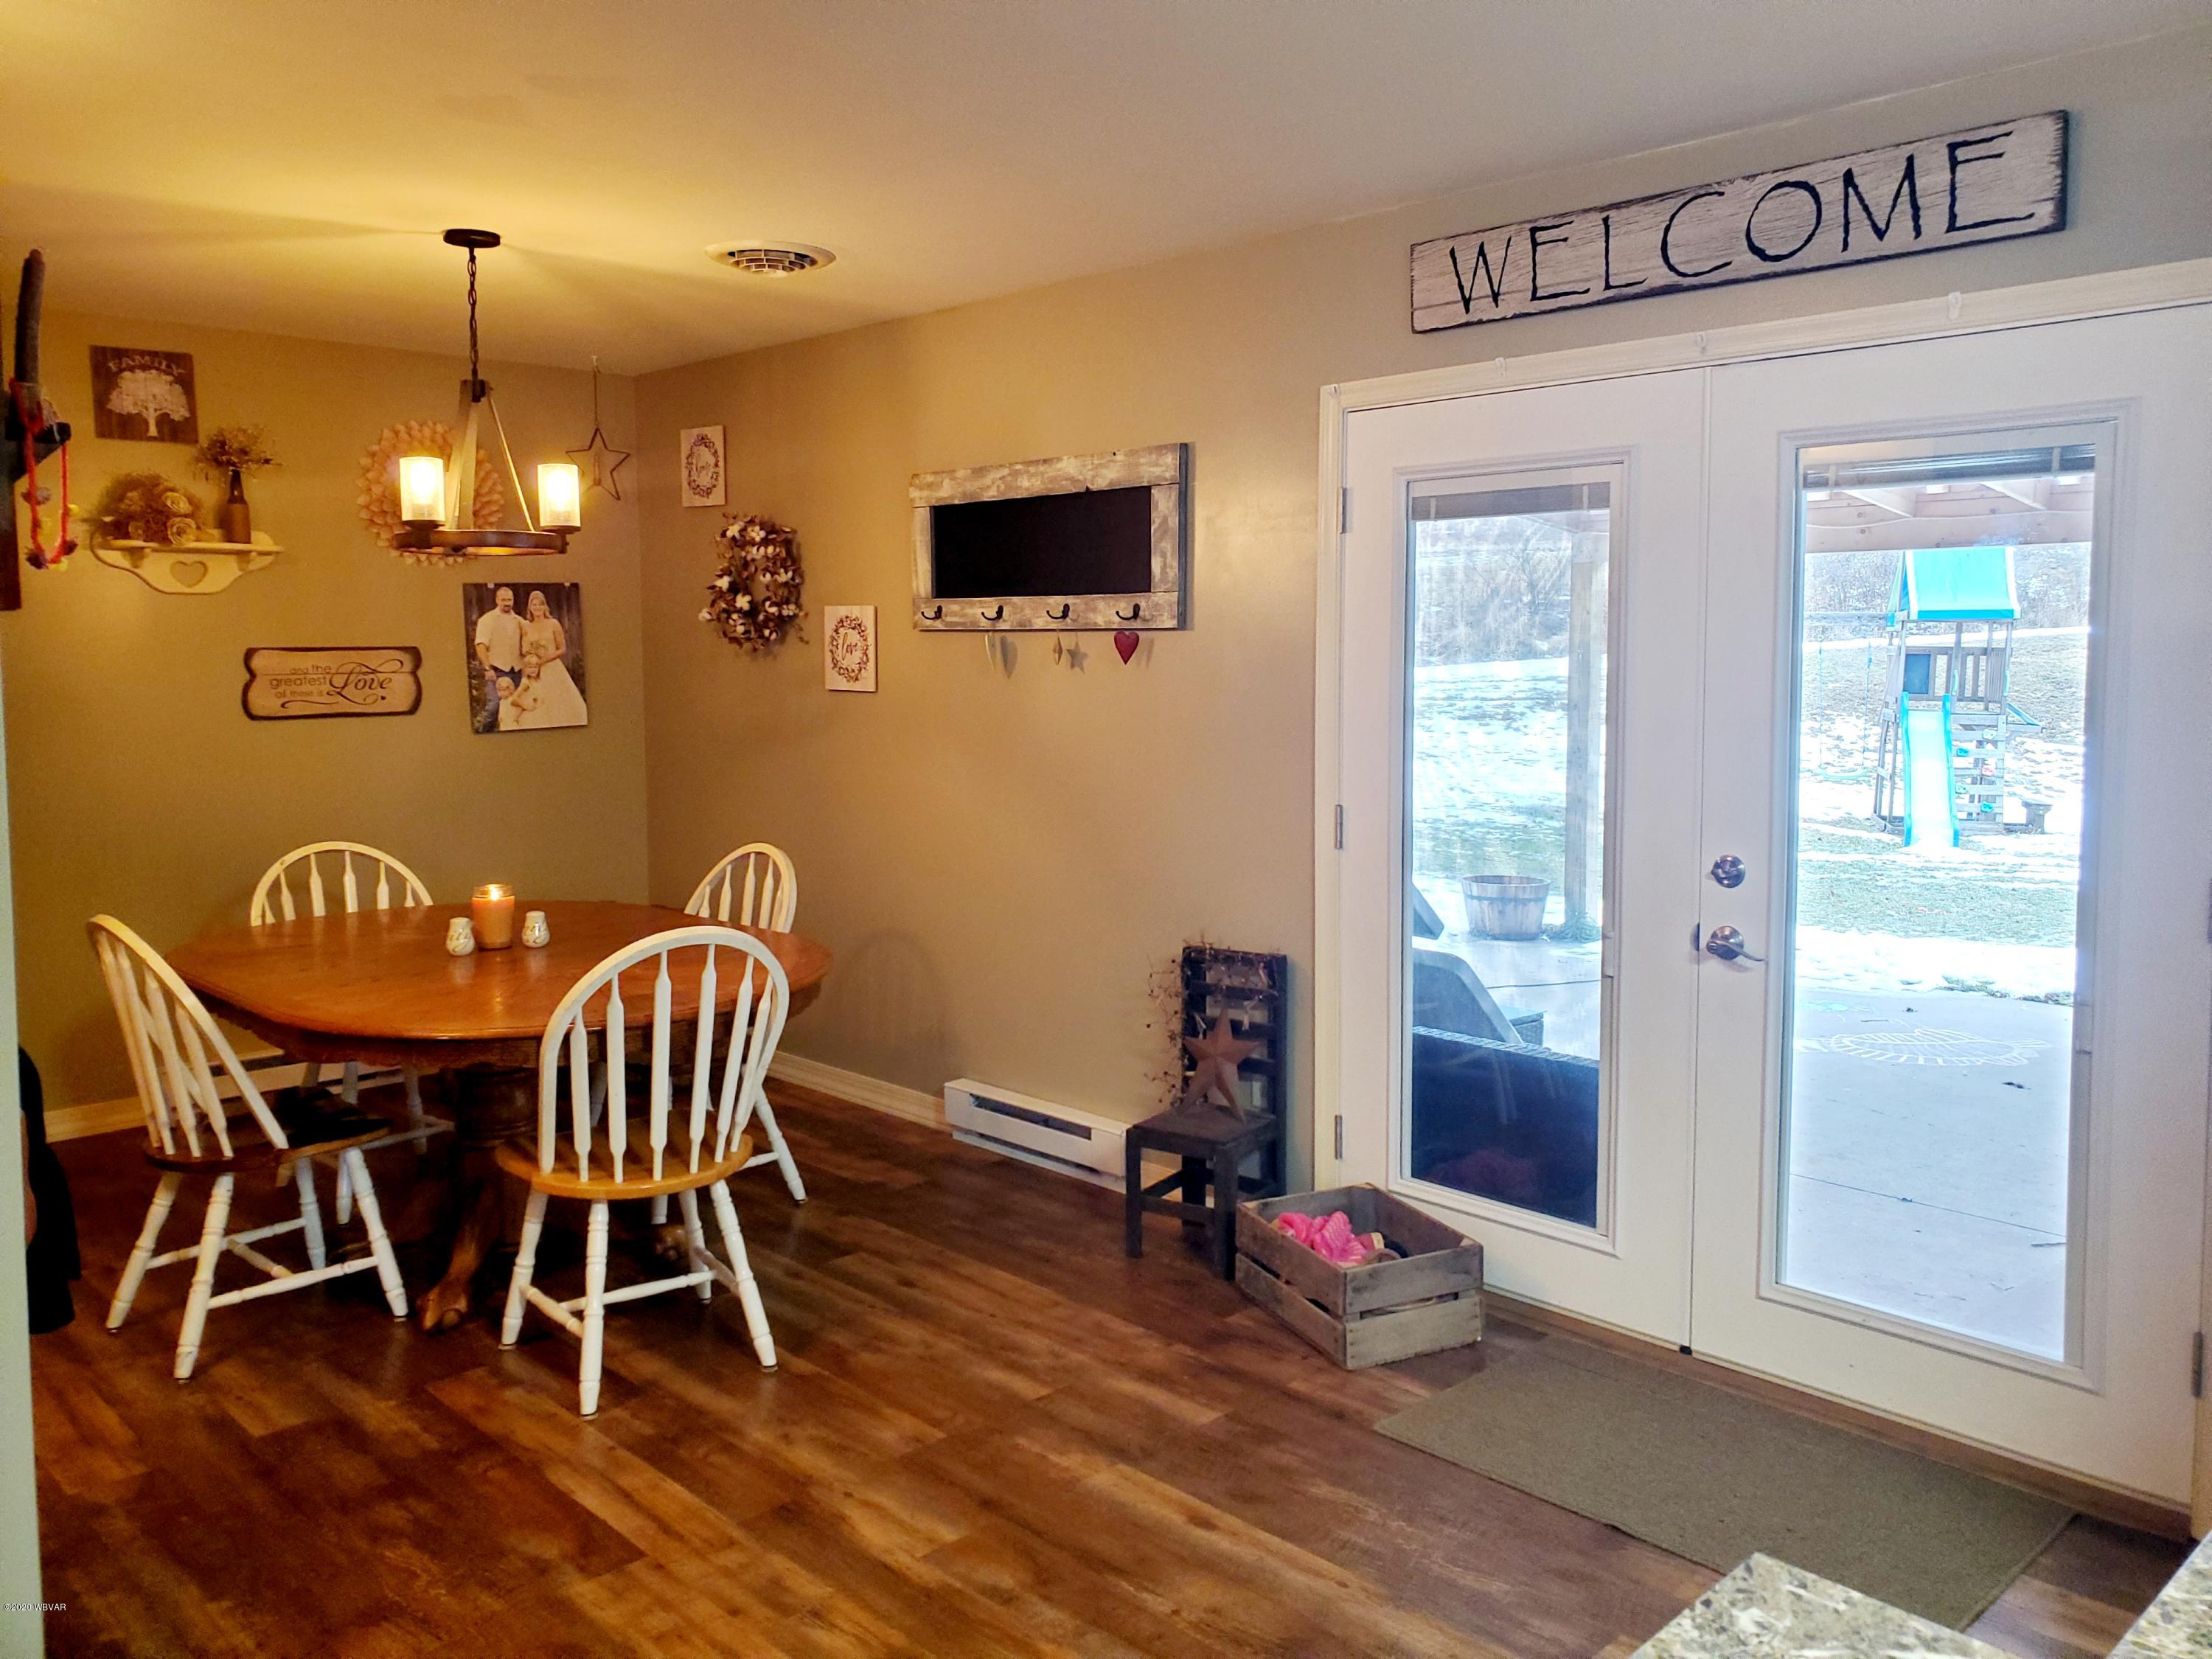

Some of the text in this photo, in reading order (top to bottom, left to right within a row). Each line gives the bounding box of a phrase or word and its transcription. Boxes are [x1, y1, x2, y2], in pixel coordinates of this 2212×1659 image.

[1449, 131, 2035, 316] WELCOME
[108, 355, 186, 377] FAMILY
[311, 664, 332, 674] the
[270, 675, 327, 689] greatest
[329, 658, 403, 705] Love
